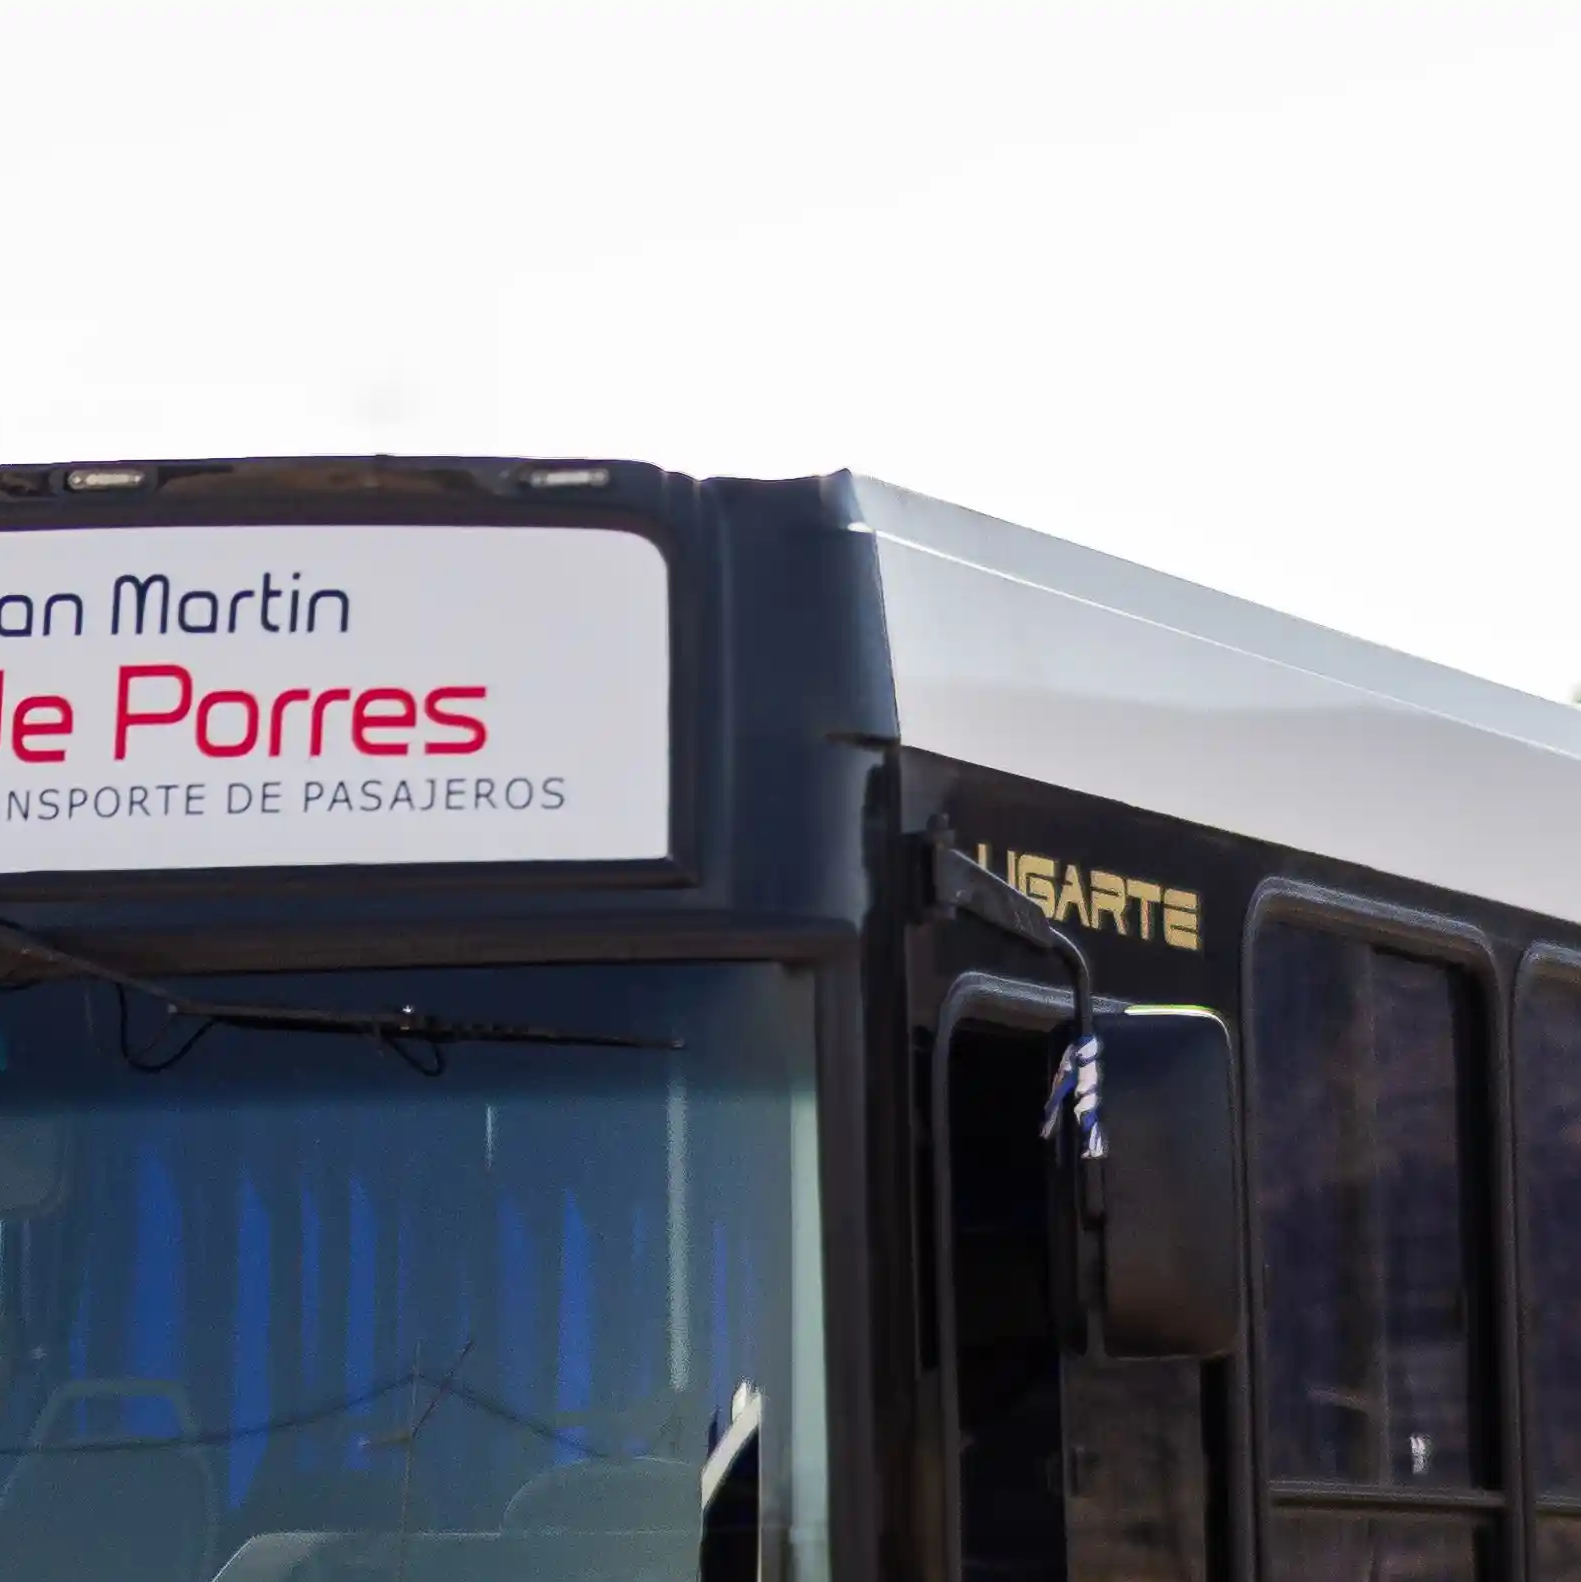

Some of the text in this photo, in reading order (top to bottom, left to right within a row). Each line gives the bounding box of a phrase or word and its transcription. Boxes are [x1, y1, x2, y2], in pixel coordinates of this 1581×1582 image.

[110, 570, 351, 636] Martin
[113, 662, 488, 761] Porres
[225, 781, 282, 814] DE
[302, 776, 566, 812] PASAJEROS
